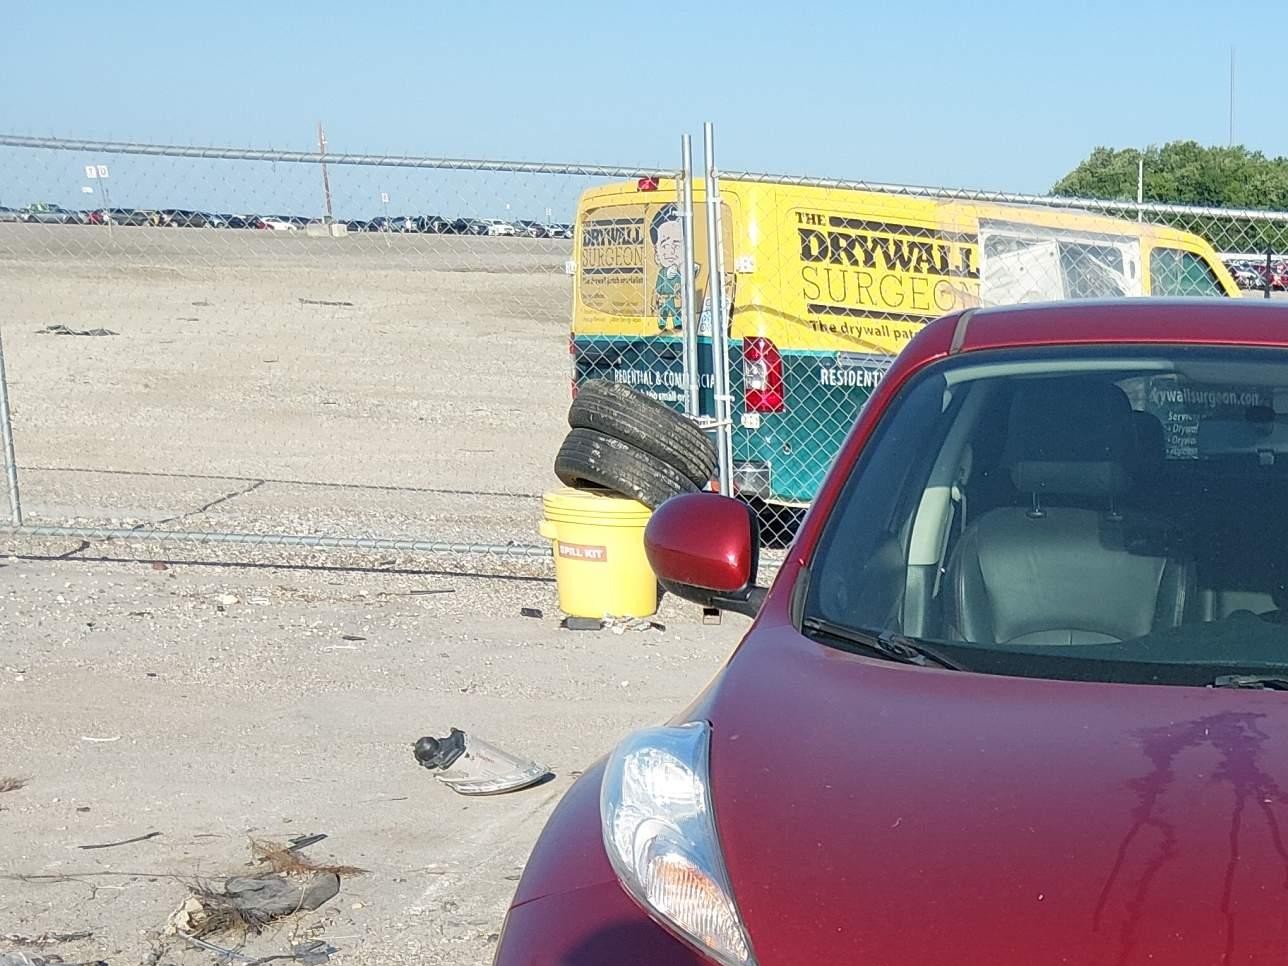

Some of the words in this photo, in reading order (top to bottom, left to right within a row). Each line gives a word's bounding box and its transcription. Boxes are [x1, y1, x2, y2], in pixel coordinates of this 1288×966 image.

[795, 211, 826, 226] THE
[583, 227, 644, 246] DRYWALL
[582, 246, 644, 267] SURGEON
[798, 228, 980, 279] DRYWALL
[801, 265, 982, 311] SURGEON
[809, 320, 836, 333] The
[840, 322, 890, 338] drywall
[655, 371, 662, 386] &
[664, 371, 715, 389] COMCIA
[560, 545, 582, 558] SPILL
[585, 549, 603, 560] KIT
